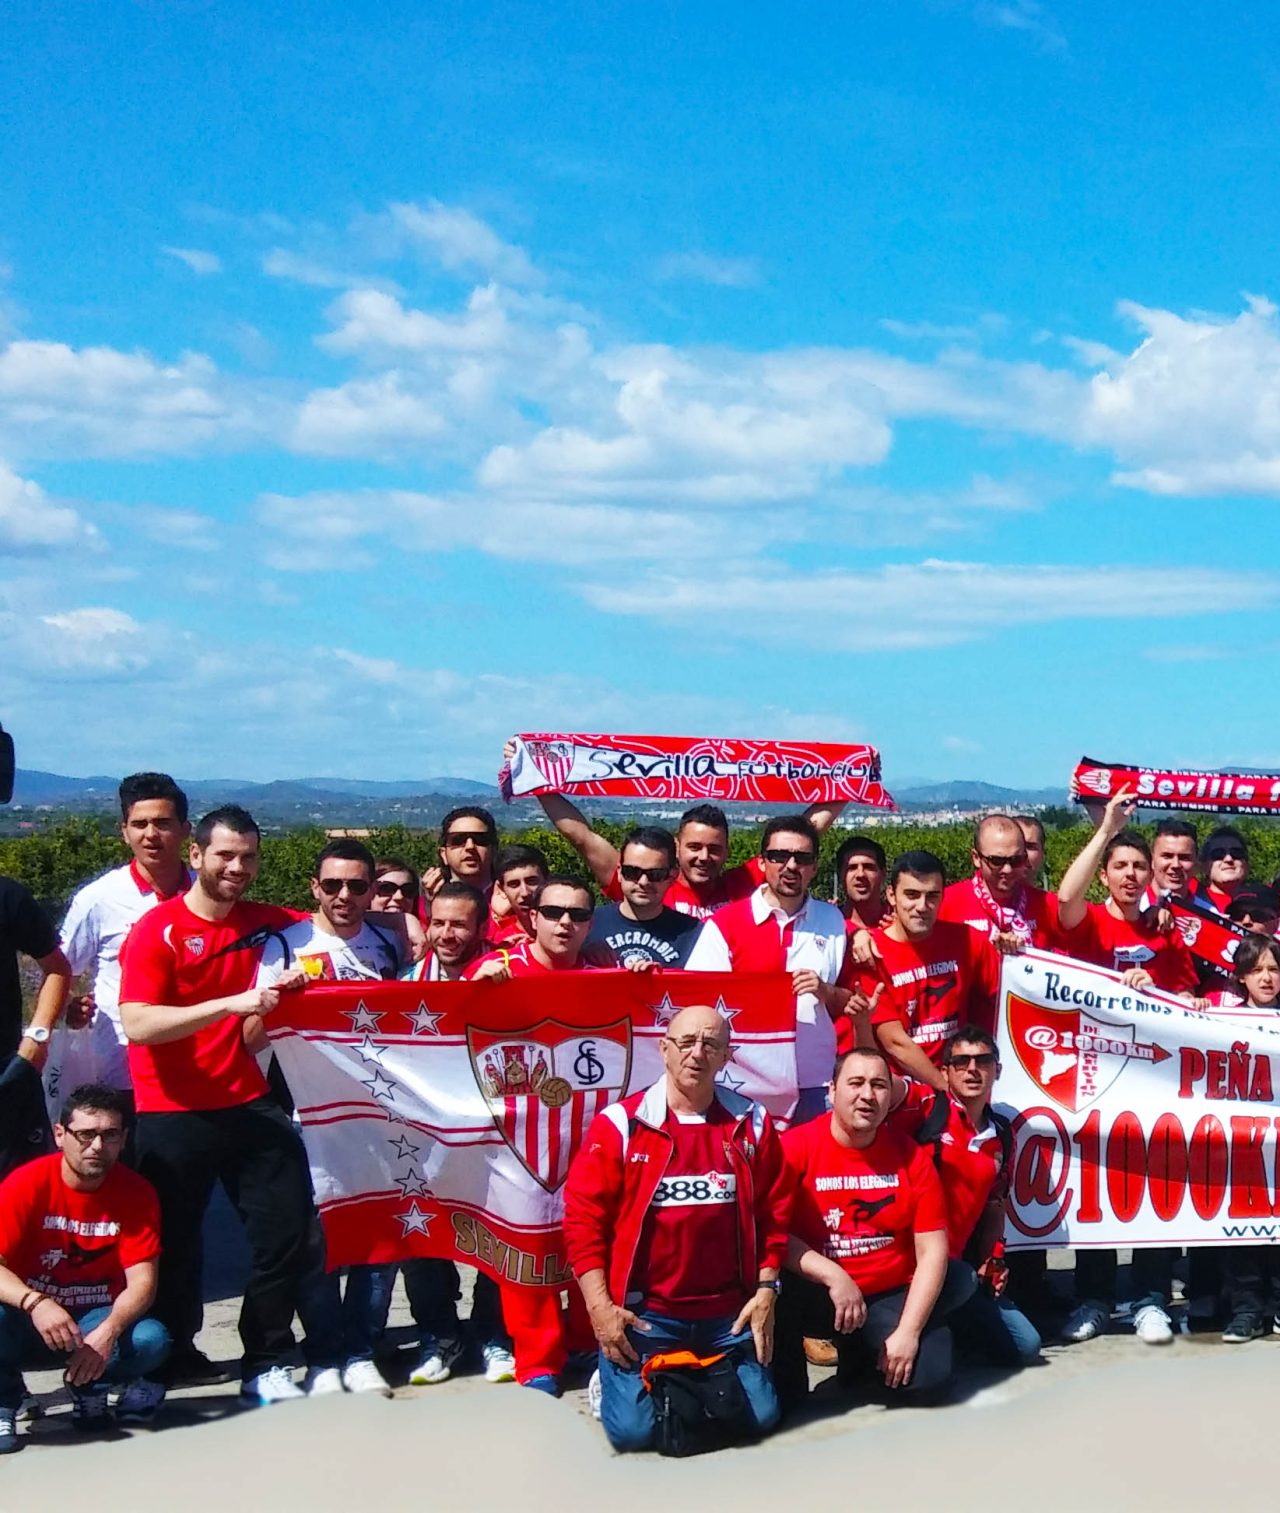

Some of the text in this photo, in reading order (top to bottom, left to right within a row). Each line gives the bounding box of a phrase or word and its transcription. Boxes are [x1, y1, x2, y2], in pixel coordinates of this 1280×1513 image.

[588, 750, 727, 779] Sevilla
[1136, 774, 1255, 801] Sevilla
[1045, 972, 1173, 1016] Recorremos
[1178, 1042, 1274, 1102] PEÑA
[653, 1180, 737, 1202] 888.co
[844, 1176, 859, 1190] LOS
